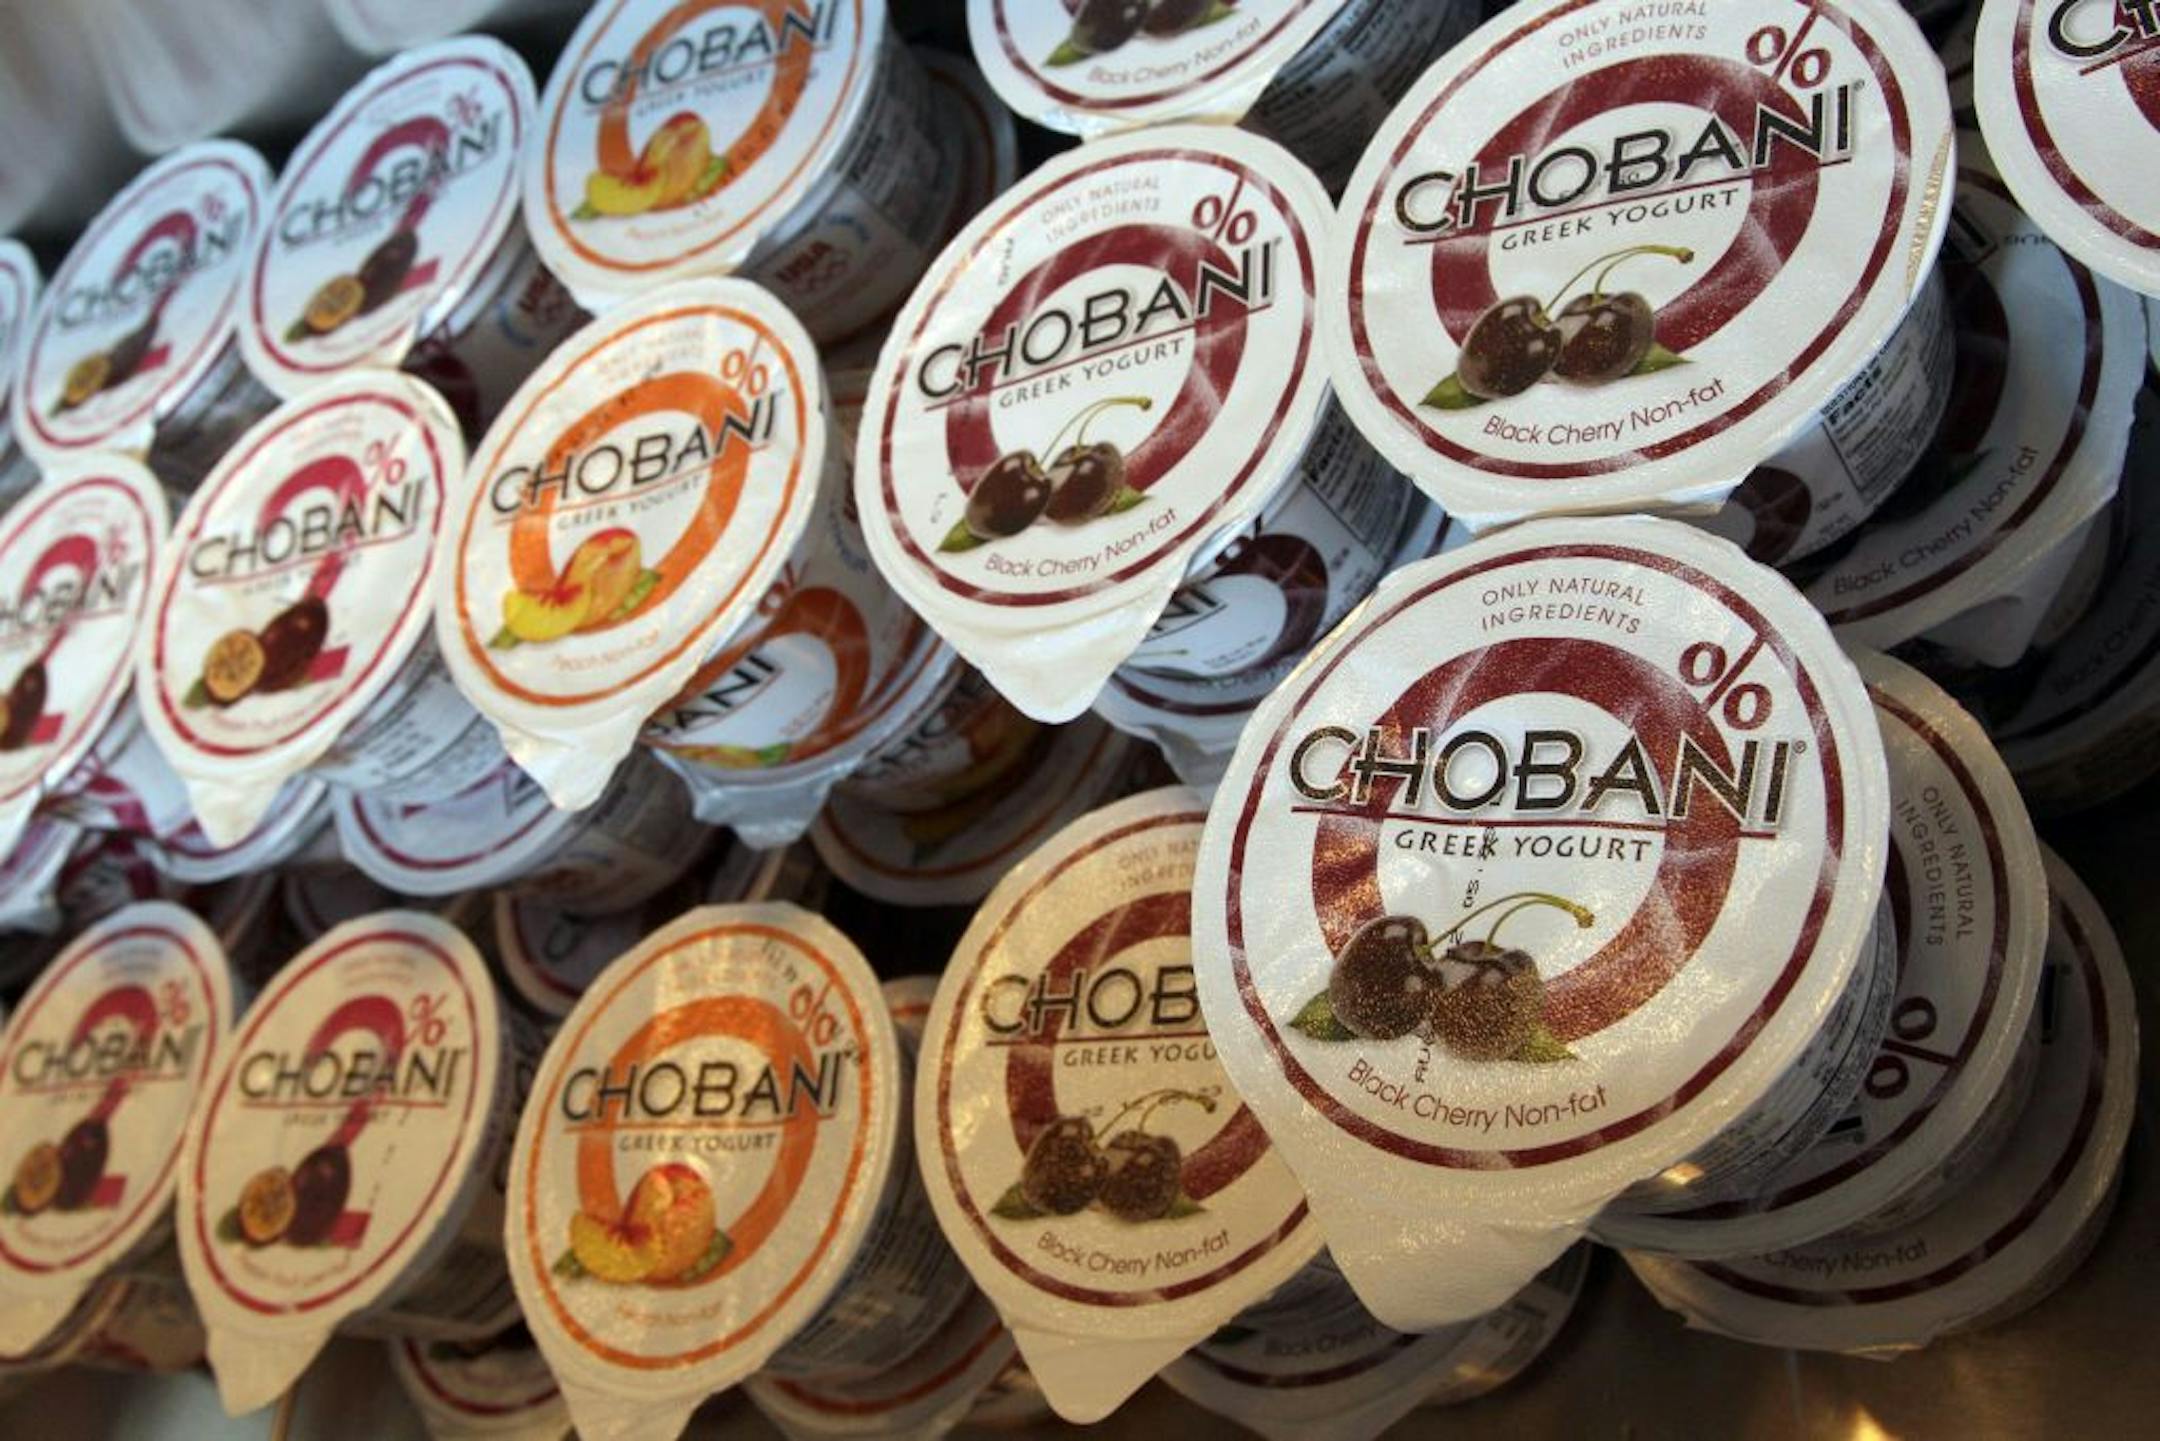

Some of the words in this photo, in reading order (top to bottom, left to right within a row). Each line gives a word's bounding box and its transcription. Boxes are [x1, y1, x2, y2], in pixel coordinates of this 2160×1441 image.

[582, 1, 839, 105] CHOBANI
[1086, 62, 1133, 85] Black
[1132, 56, 1190, 86] Cherry
[1193, 16, 1263, 75] Non-fat
[1558, 16, 1610, 48] ONLY
[1617, 1, 1707, 26] NATURAL
[1562, 24, 1708, 69] INGREDIENTS
[278, 114, 500, 246] CHOBANI
[1396, 82, 1852, 233] CHOBANI
[1041, 190, 1084, 225] ONLY
[1087, 174, 1161, 205] NATURAL
[1045, 197, 1161, 246] INGREDIENTS
[1500, 217, 1594, 253] GREEK
[1607, 187, 1741, 229] YOGURT
[917, 240, 1275, 401] CHOBANI
[998, 371, 1072, 410] GREEK
[1081, 336, 1189, 383] YOGURT
[1482, 414, 1542, 444] Black
[1546, 418, 1625, 446] Cherry
[1629, 376, 1726, 432] Non-fat
[490, 393, 778, 517] CHOBANI
[189, 474, 428, 582] CHOBANI
[983, 549, 1034, 579] Black
[1036, 550, 1104, 580] Cherry
[1105, 506, 1180, 561] Non-fat
[1832, 559, 1895, 596] Black
[1899, 515, 1976, 572] Cherry
[1974, 444, 2040, 530] Non-fat
[1480, 578, 1542, 609] ONLY
[1548, 576, 1653, 609] NATURAL
[1480, 601, 1643, 637] INGREDIENTS
[1289, 722, 1794, 828] CHOBANI
[1395, 827, 1498, 861] GREEK
[1512, 833, 1654, 864] YOGURT
[1895, 800, 1949, 948] INGREDIENTS
[1918, 784, 1960, 839] ONLY
[1947, 842, 1976, 942] NATURAL
[237, 1046, 460, 1103] CHOBANI
[560, 1047, 844, 1123] CHOBANI
[1062, 1044, 1138, 1069] GREEK
[1346, 1056, 1409, 1111] Black
[1412, 1091, 1501, 1134] Cherry
[1502, 1083, 1610, 1132] Non-fat
[617, 1133, 683, 1154] GREEK
[689, 1131, 778, 1154] YOGURT
[1036, 1230, 1085, 1269] Black
[1086, 1249, 1150, 1279] Cherry
[1153, 1228, 1232, 1273] Non-fat
[1840, 1236, 1930, 1274] Non-fat
